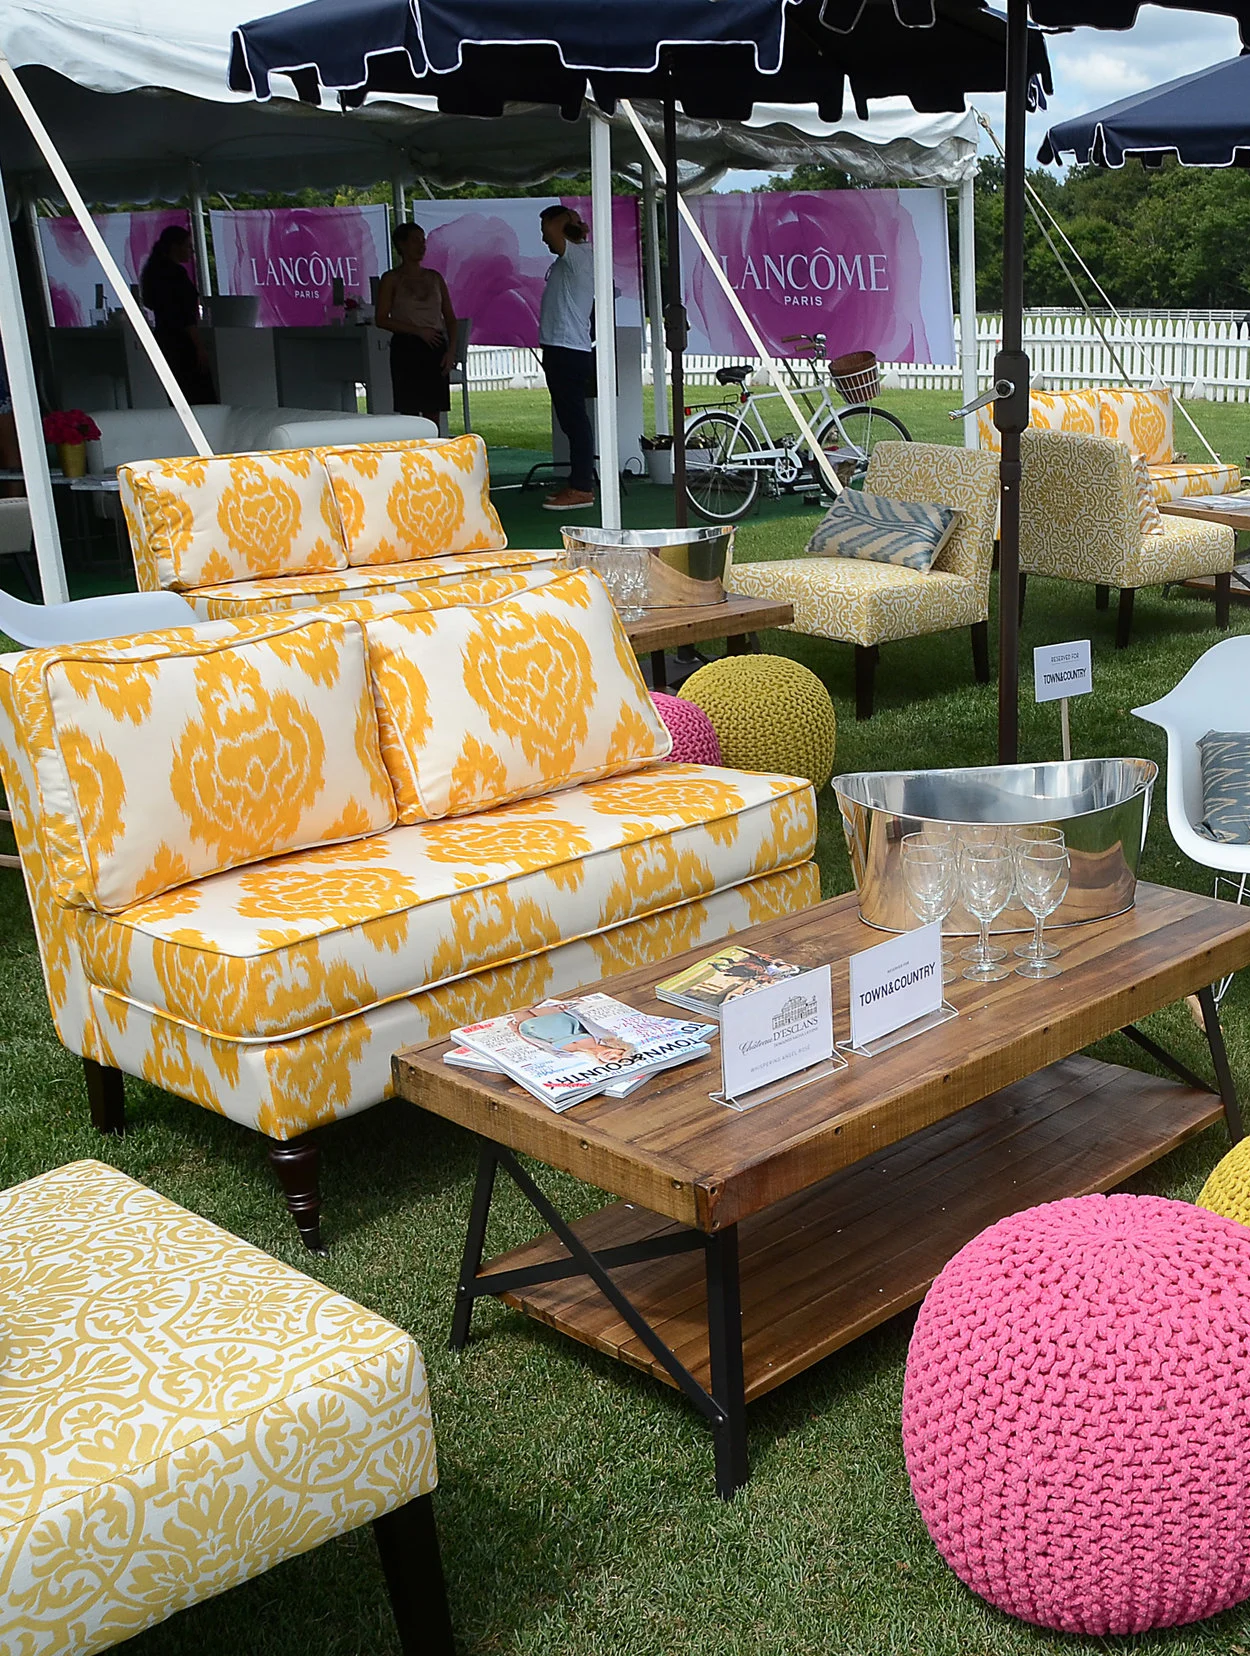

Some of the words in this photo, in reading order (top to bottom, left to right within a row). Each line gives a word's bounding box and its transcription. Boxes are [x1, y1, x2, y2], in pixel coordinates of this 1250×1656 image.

[251, 251, 359, 286] LANCÔME
[720, 246, 888, 291] LANCÔME
[295, 290, 319, 299] PARIS
[784, 296, 823, 306] PARIS
[1051, 654, 1071, 662] RESERVED
[1043, 668, 1086, 684] TOWN&COUNTRY
[859, 962, 936, 1006] TOWN&COUNTRY
[773, 1016, 819, 1041] D'ESCLANS
